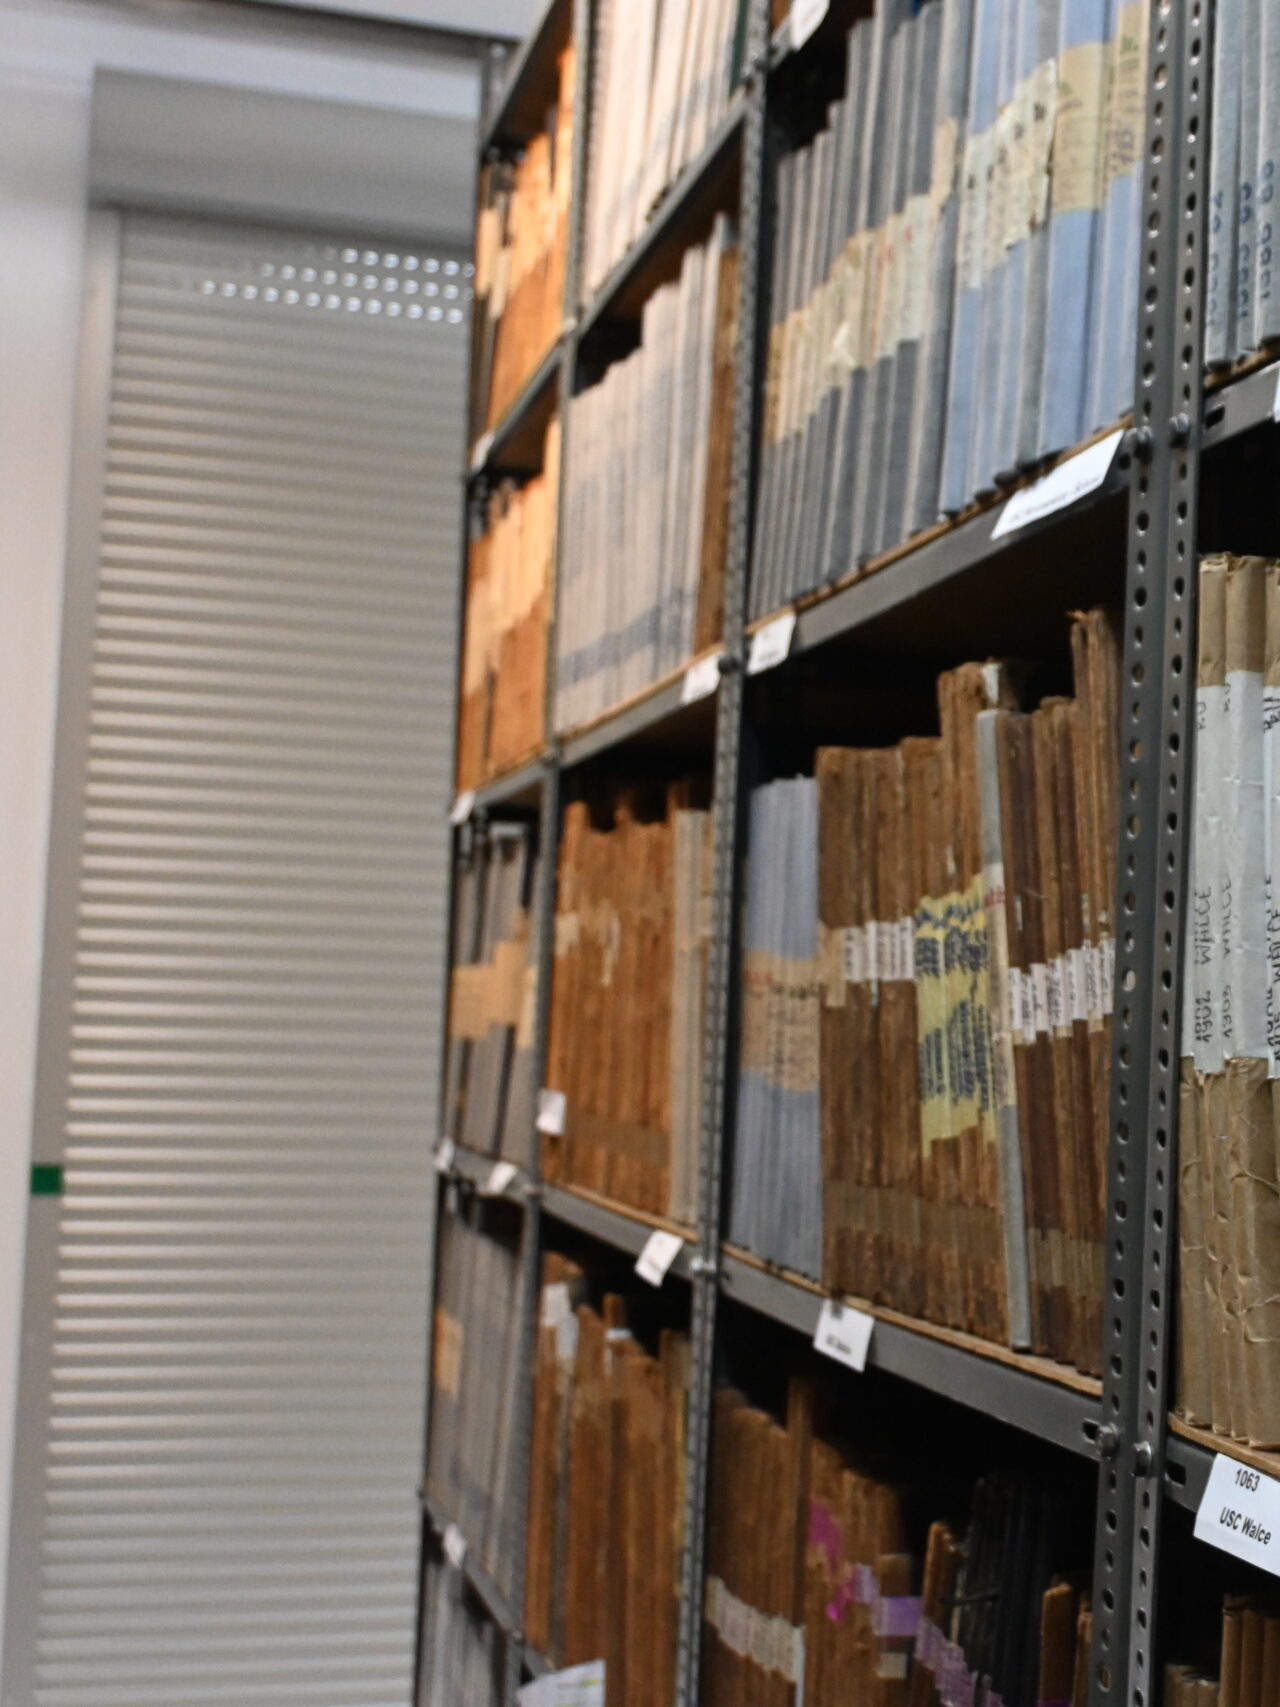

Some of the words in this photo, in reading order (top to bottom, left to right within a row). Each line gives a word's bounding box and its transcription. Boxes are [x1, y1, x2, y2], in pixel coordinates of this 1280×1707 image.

[1234, 1468, 1261, 1492] 1063
[1219, 1506, 1242, 1530] USC
[1241, 1516, 1272, 1545] Walce
